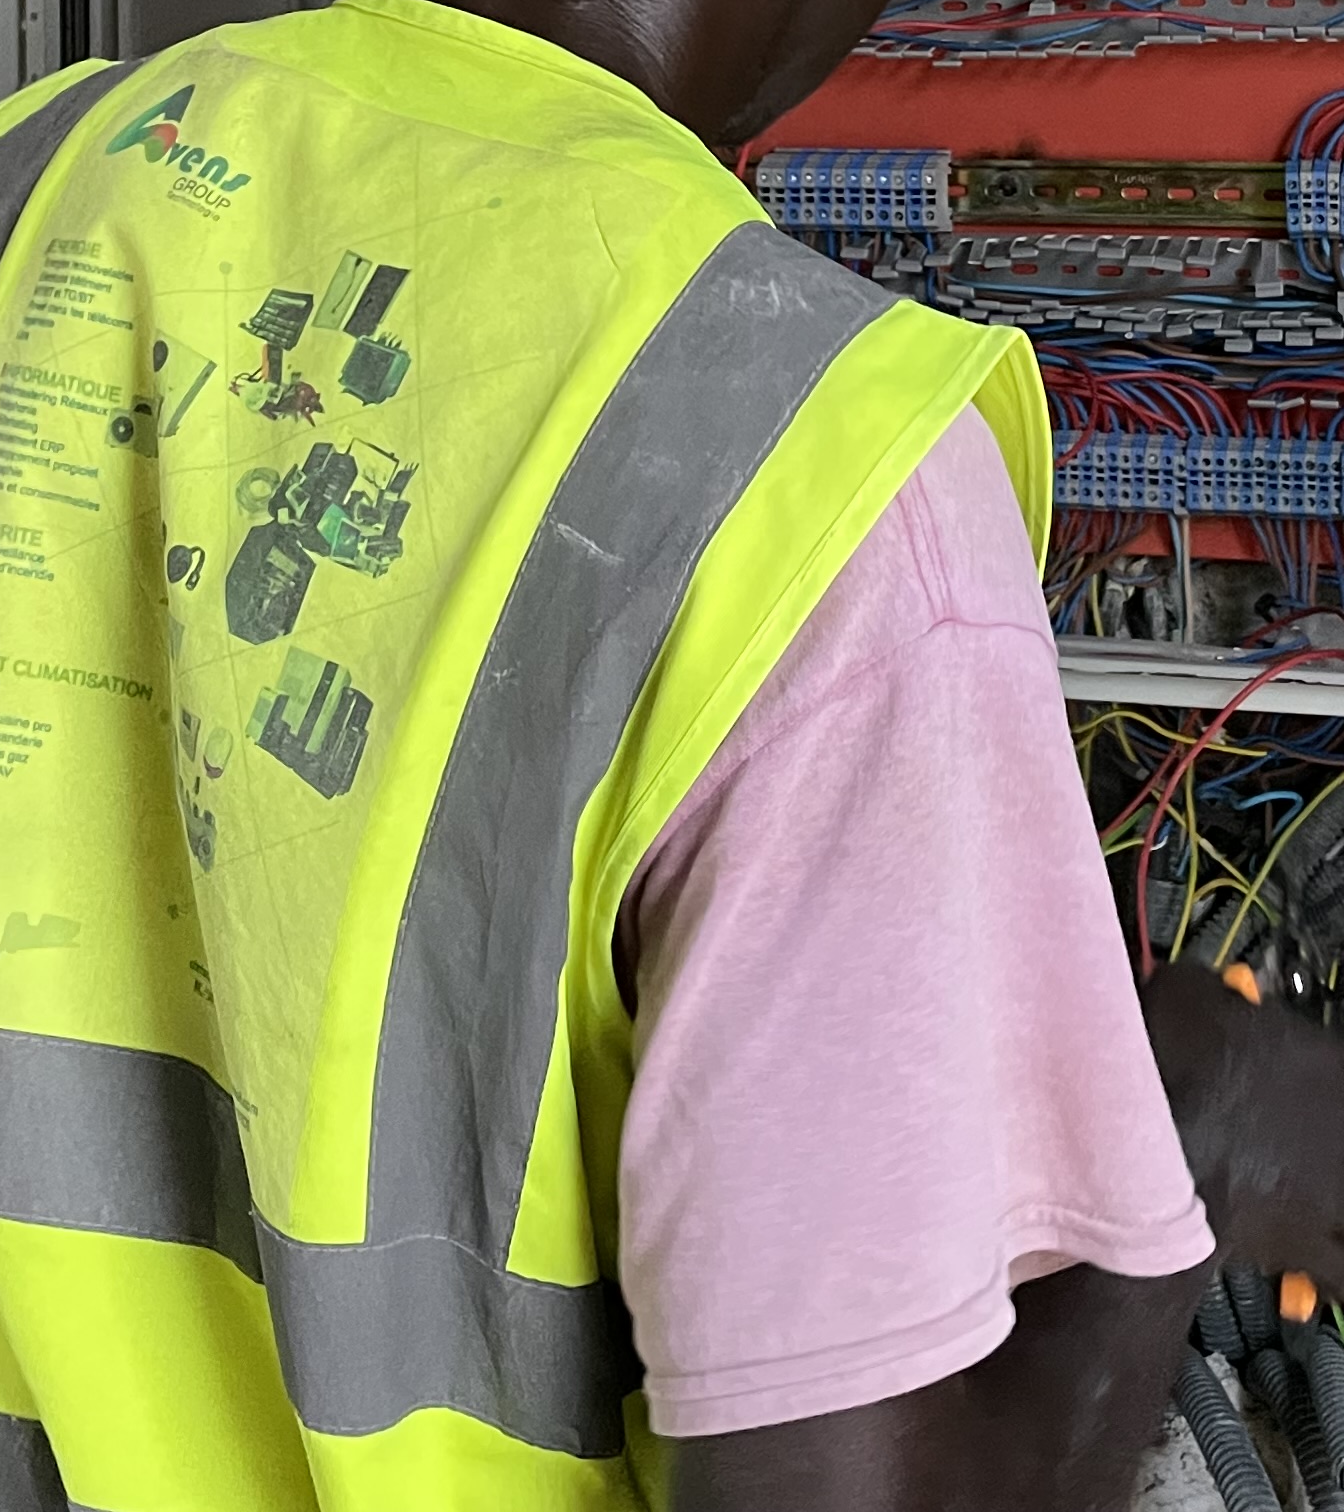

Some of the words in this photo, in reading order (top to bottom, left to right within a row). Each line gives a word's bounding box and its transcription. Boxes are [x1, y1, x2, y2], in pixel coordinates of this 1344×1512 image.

[172, 176, 232, 209] GROUP
[12, 659, 154, 701] CLIMATISATION
[32, 721, 52, 733] pro
